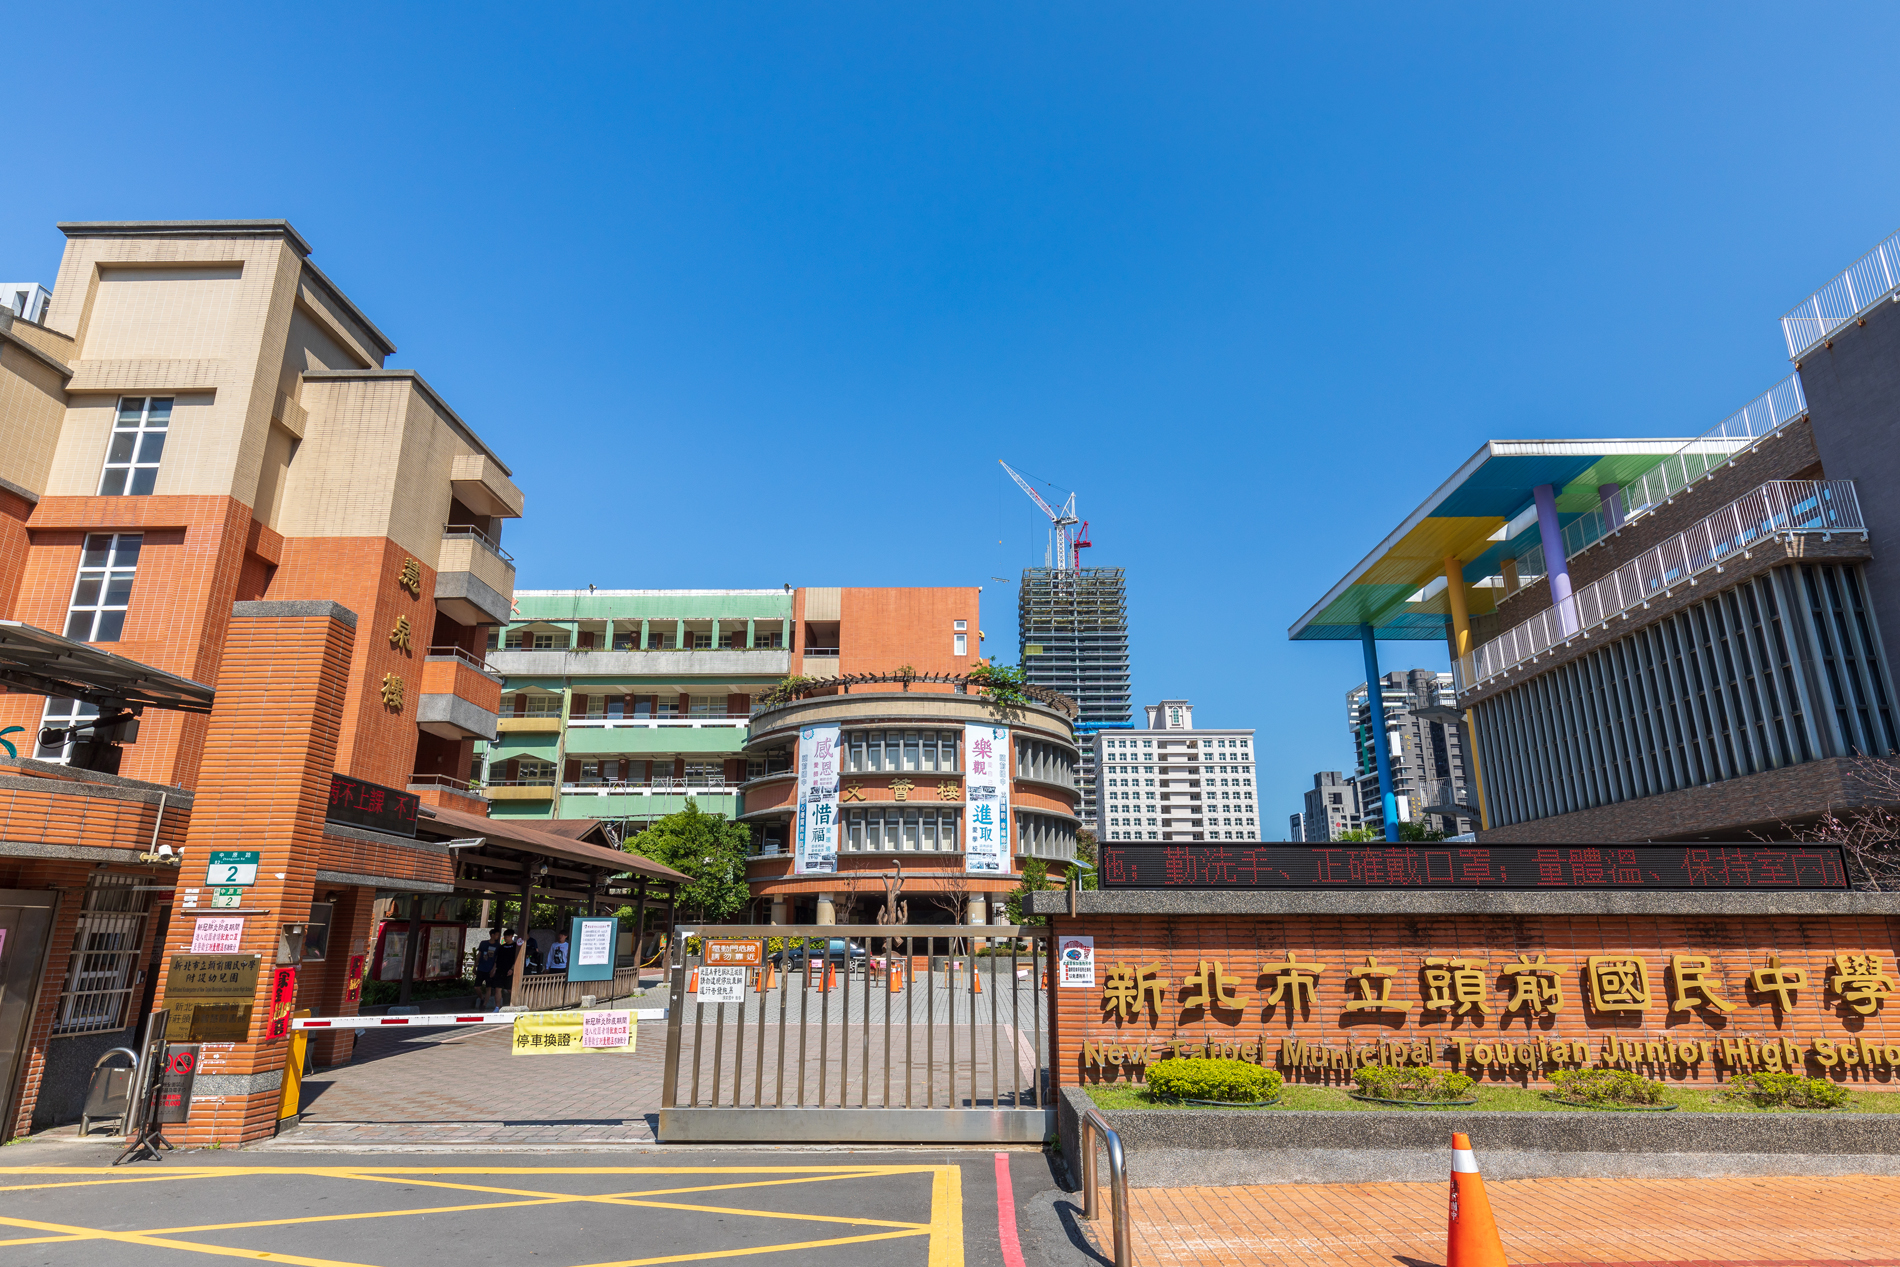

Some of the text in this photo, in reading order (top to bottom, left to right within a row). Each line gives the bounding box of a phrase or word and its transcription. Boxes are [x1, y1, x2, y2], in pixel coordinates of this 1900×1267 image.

[381, 557, 421, 710] 慧泉樓
[814, 737, 834, 776] 感恩
[972, 737, 993, 776] 樂觀
[811, 803, 832, 843] 惜福
[972, 803, 993, 842] 進取
[225, 866, 238, 882] 2
[225, 897, 233, 906] 2
[711, 945, 756, 953] 電動門危險
[711, 953, 755, 961] 請勿靠近
[173, 960, 256, 972] 新北市立頭前國民中學
[185, 972, 239, 983] 附設幼兒園
[1103, 952, 1896, 1018] 新北市立頭前國民中學
[585, 1017, 628, 1026] 新冠肺炎防疫期間
[1084, 1039, 1152, 1068] New
[1281, 1036, 1440, 1070] Municipal
[1449, 1035, 1592, 1072] Touqian
[1599, 1035, 1712, 1064] Junior
[1719, 1037, 1804, 1073] High
